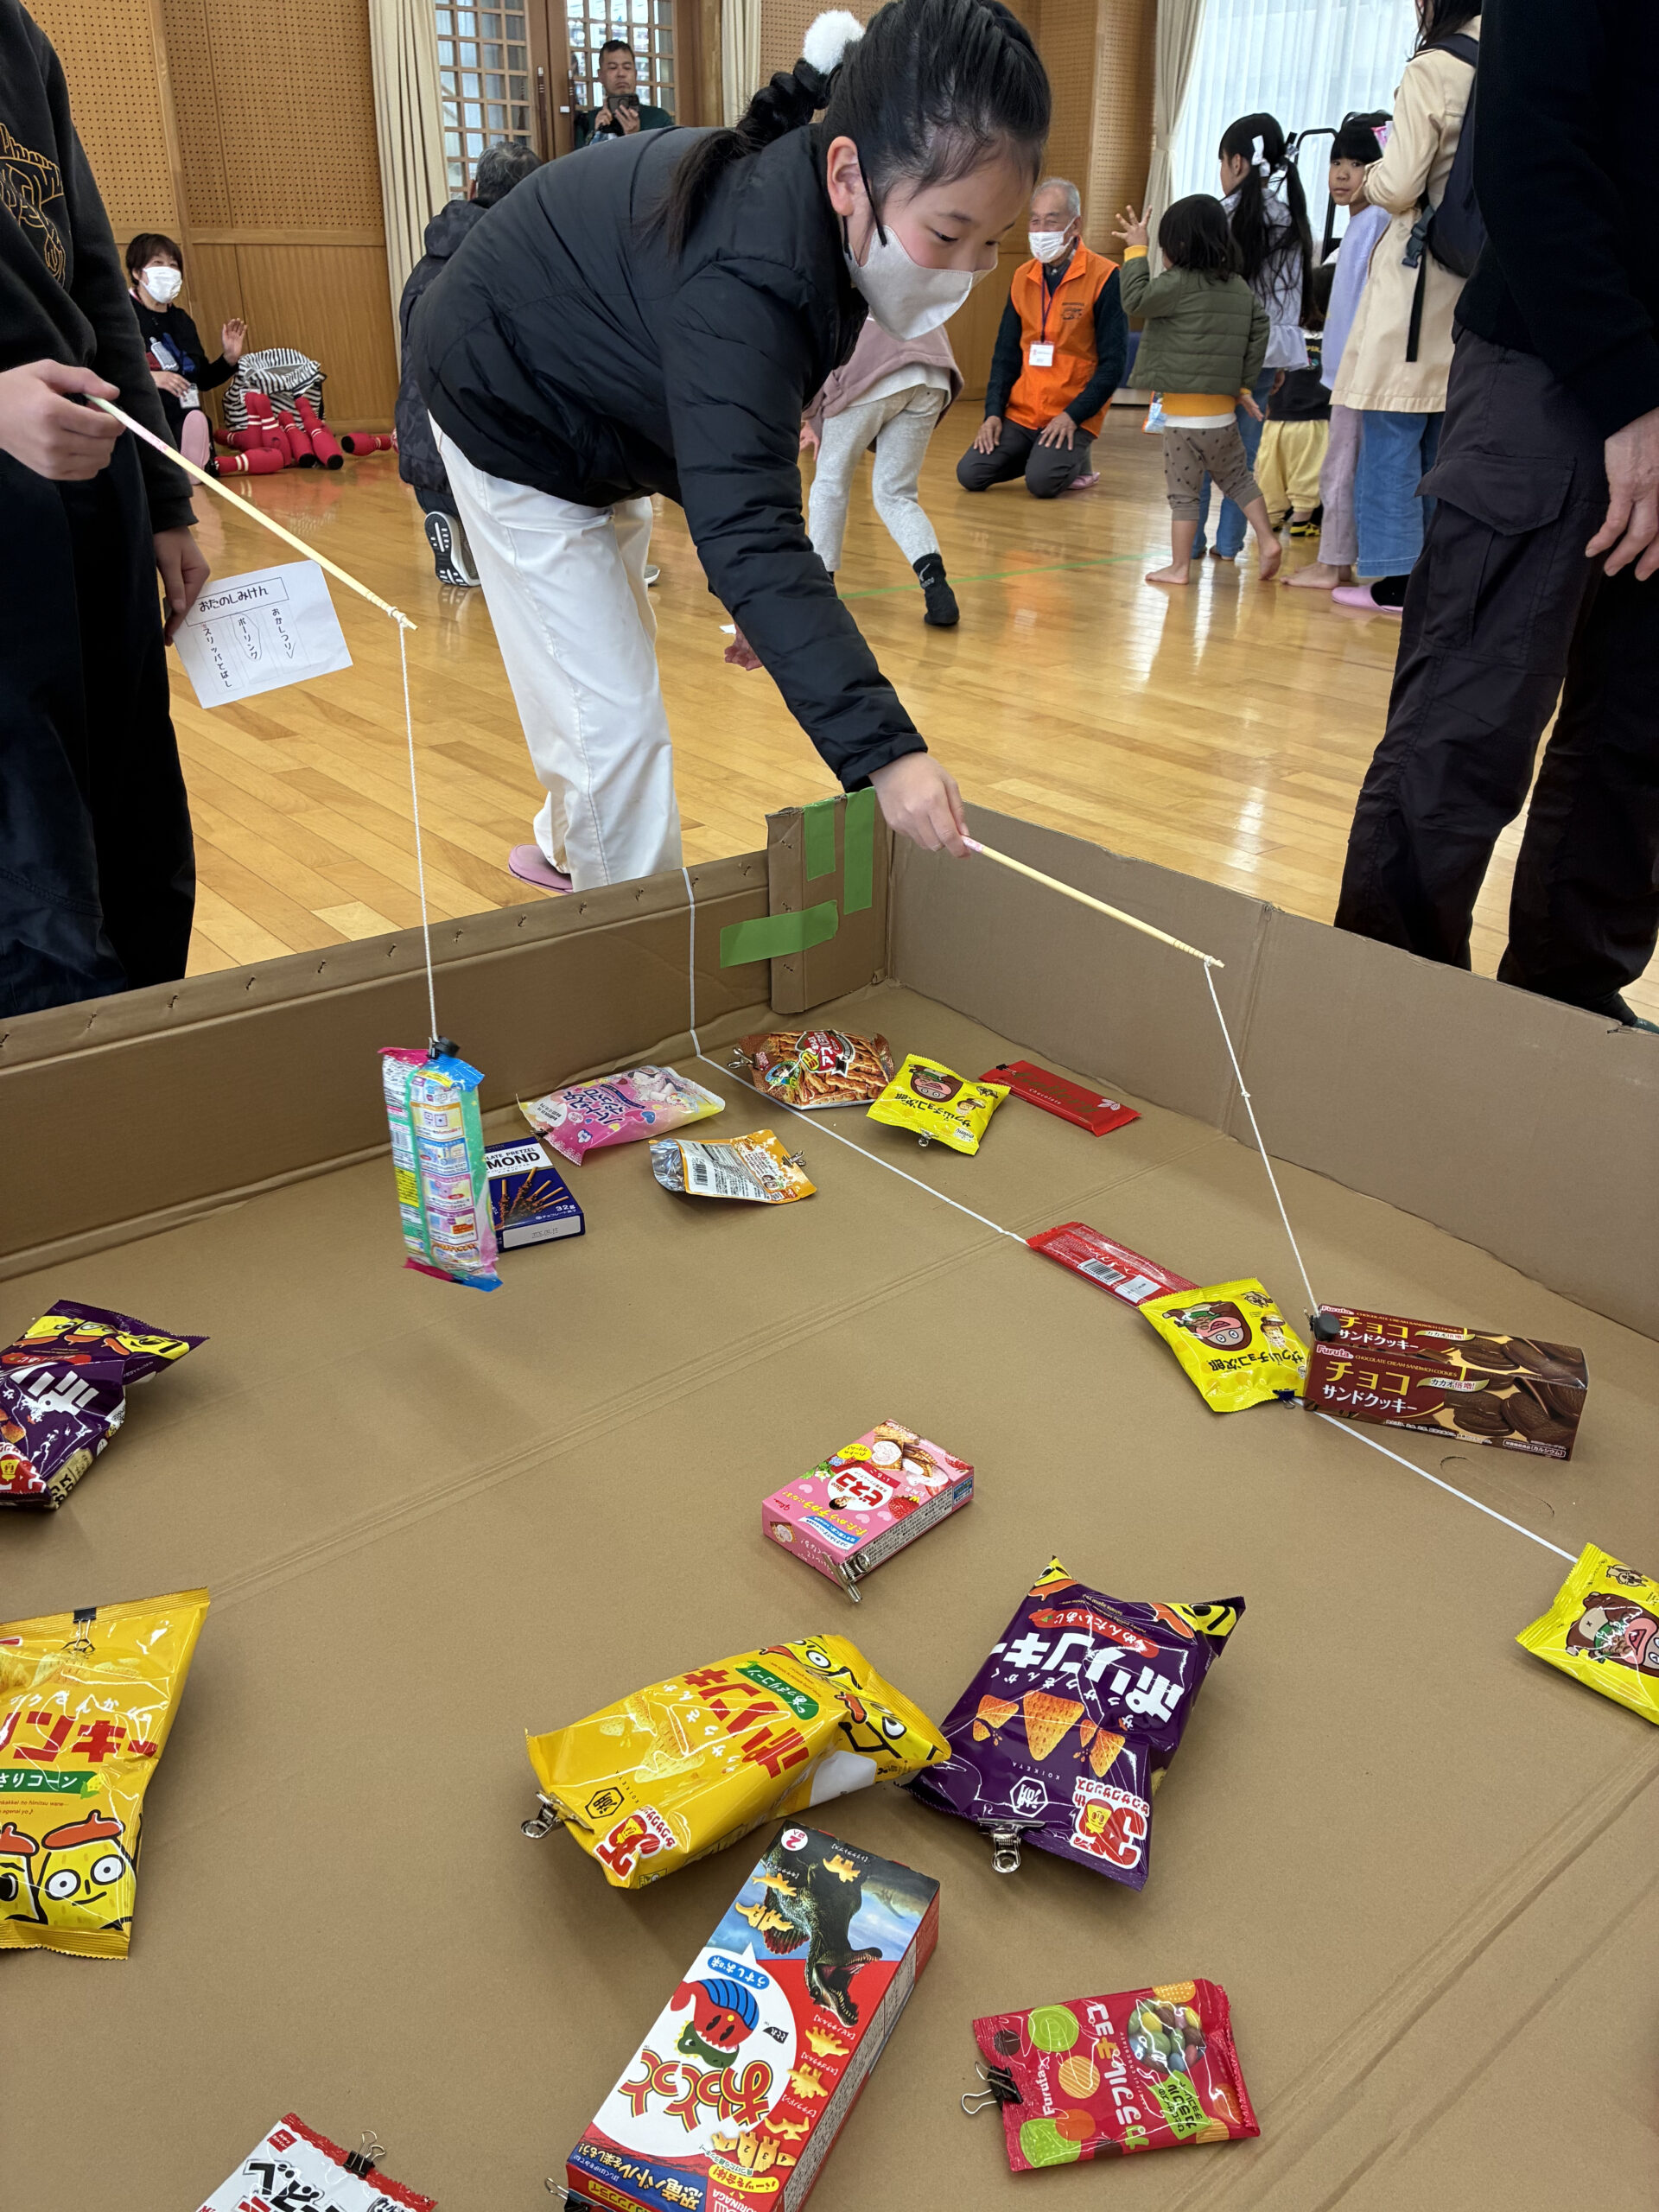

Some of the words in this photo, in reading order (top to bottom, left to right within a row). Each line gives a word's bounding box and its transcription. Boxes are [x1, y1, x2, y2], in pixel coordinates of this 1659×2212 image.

[200, 586, 269, 613] おたのしみけん
[237, 617, 258, 660] ボーリング
[271, 607, 292, 651] おかしつり
[202, 627, 232, 688] スリッパとばし
[1028, 1087, 1063, 1105] Chocolate
[486, 1152, 540, 1171] MOND
[505, 1147, 535, 1156] PRETZEL
[1321, 1305, 1353, 1315] Furuta
[1339, 1313, 1408, 1339] チョコ
[1316, 1344, 1350, 1359] Furuta
[1338, 1328, 1419, 1351] サンドクッキー
[1210, 1349, 1306, 1372] サク山チョコ次郎
[1355, 1353, 1387, 1365] CHOCOLATE
[1386, 1359, 1407, 1368] CREAM
[1406, 1363, 1434, 1374] SANDWICH
[1433, 1368, 1458, 1377] COOKIES
[1325, 1360, 1411, 1396] チョコ
[1430, 1377, 1476, 1390] カカオ倍増!
[1322, 1384, 1418, 1413] サンドクッキー
[830, 1482, 846, 1492] Bisco
[836, 1471, 884, 1507] ビスコ
[869, 1469, 891, 1483] いちご
[829, 1514, 868, 1536] たたかう
[1052, 1610, 1141, 1645] めんたいあじ
[988, 1631, 1185, 1723] ポリンキー
[747, 1668, 808, 1715] あっさりコーン
[990, 1668, 1135, 1729] サクサクさんかく
[683, 1668, 810, 1780] ポリンキ
[1012, 1761, 1061, 1781] KOIKEYA
[614, 1770, 641, 1805] KOIKEYA
[1016, 1783, 1043, 1810] 湖
[592, 1791, 619, 1815] 湖
[785, 1835, 802, 1849] 2
[709, 1955, 766, 1987] うすしお味
[770, 2026, 786, 2042] とと丸
[1086, 2004, 1150, 2150] カラフルチョコ
[617, 2048, 773, 2133] おっとっと
[1036, 2068, 1056, 2116] Furuta
[1166, 2084, 1198, 2129] カラフル
[743, 2145, 750, 2154] 2
[761, 2152, 768, 2160] 3
[578, 2142, 703, 2212] 恐竜バトルを楽しもう!
[712, 2188, 760, 2212] ORINAGA
